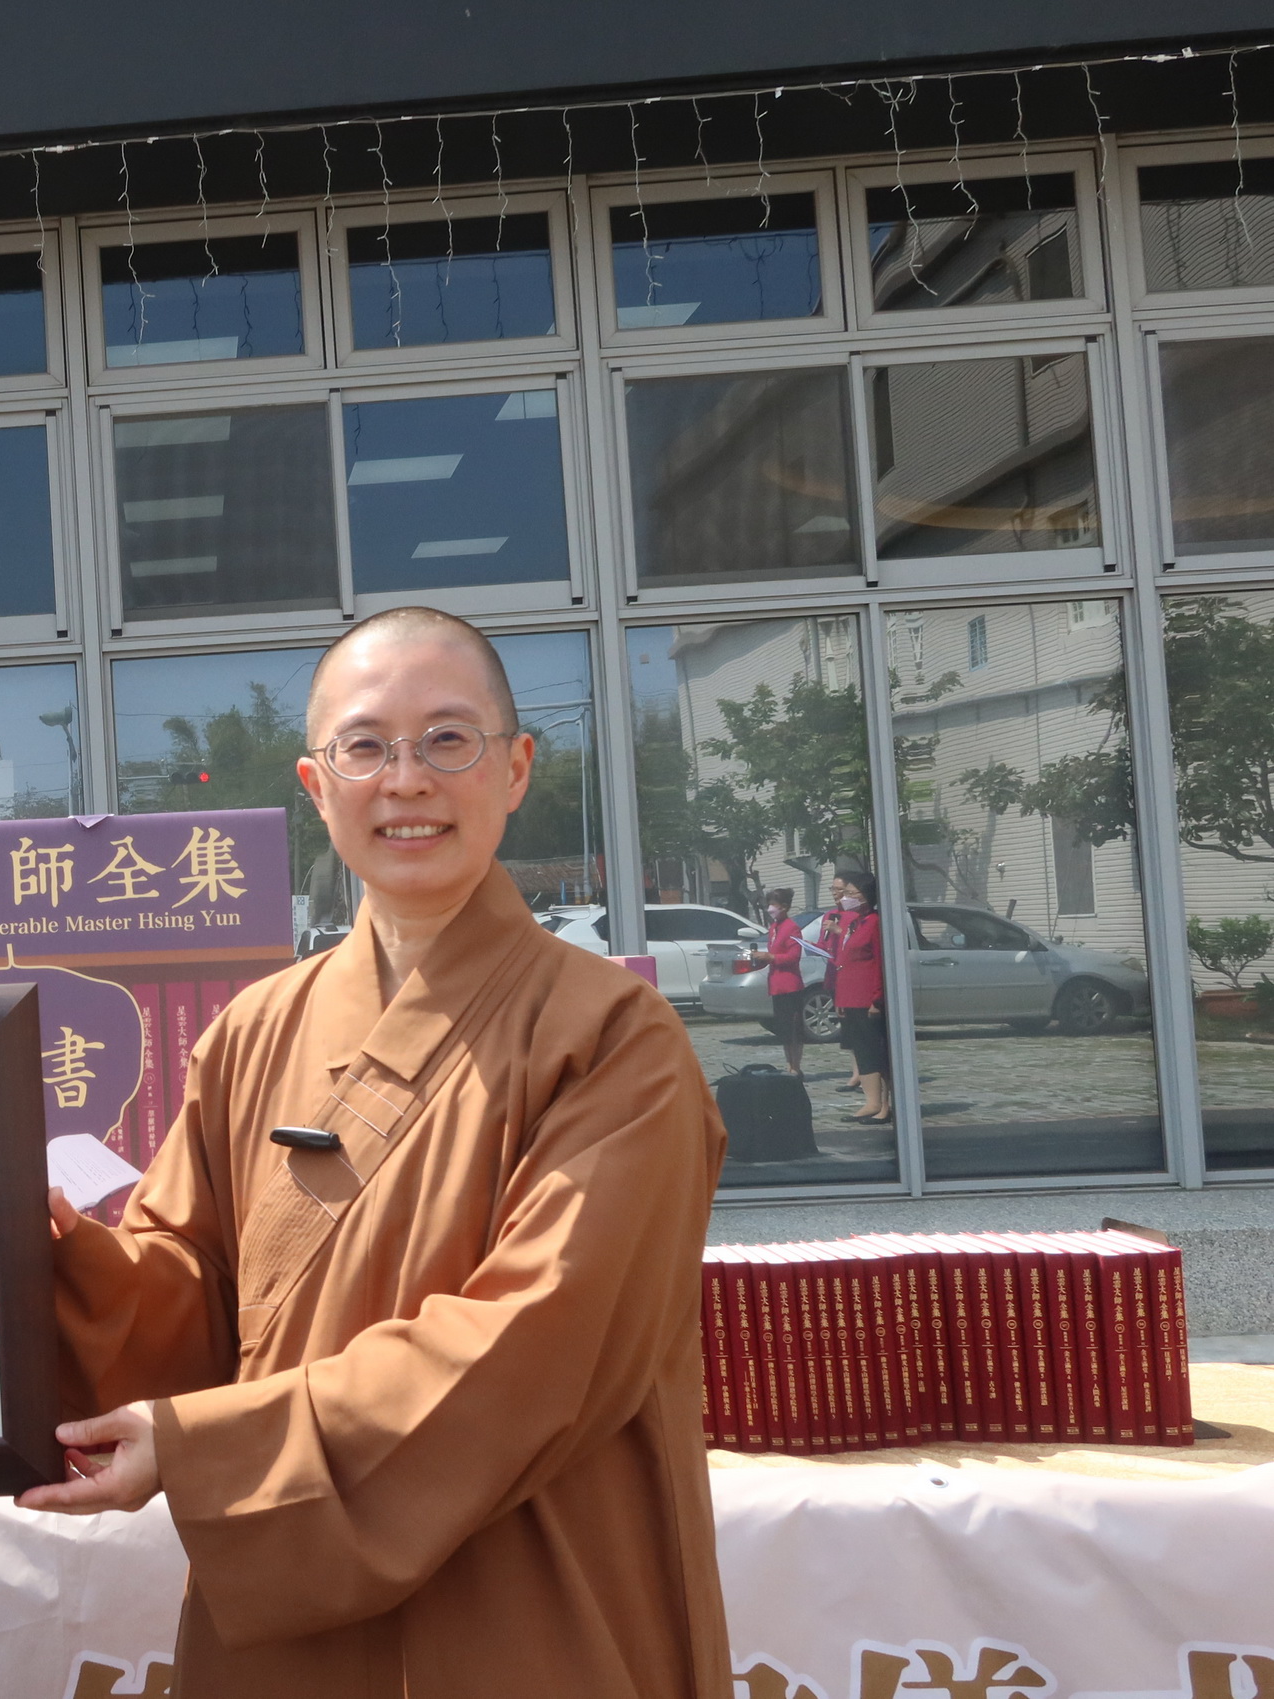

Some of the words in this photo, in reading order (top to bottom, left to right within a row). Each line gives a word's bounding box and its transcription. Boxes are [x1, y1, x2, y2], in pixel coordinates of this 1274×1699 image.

[66, 915, 131, 932] Master
[138, 912, 194, 931] Hsing
[201, 910, 241, 926] Yun
[41, 1026, 105, 1108] 書
[142, 1007, 154, 1069] 星雲大師全集
